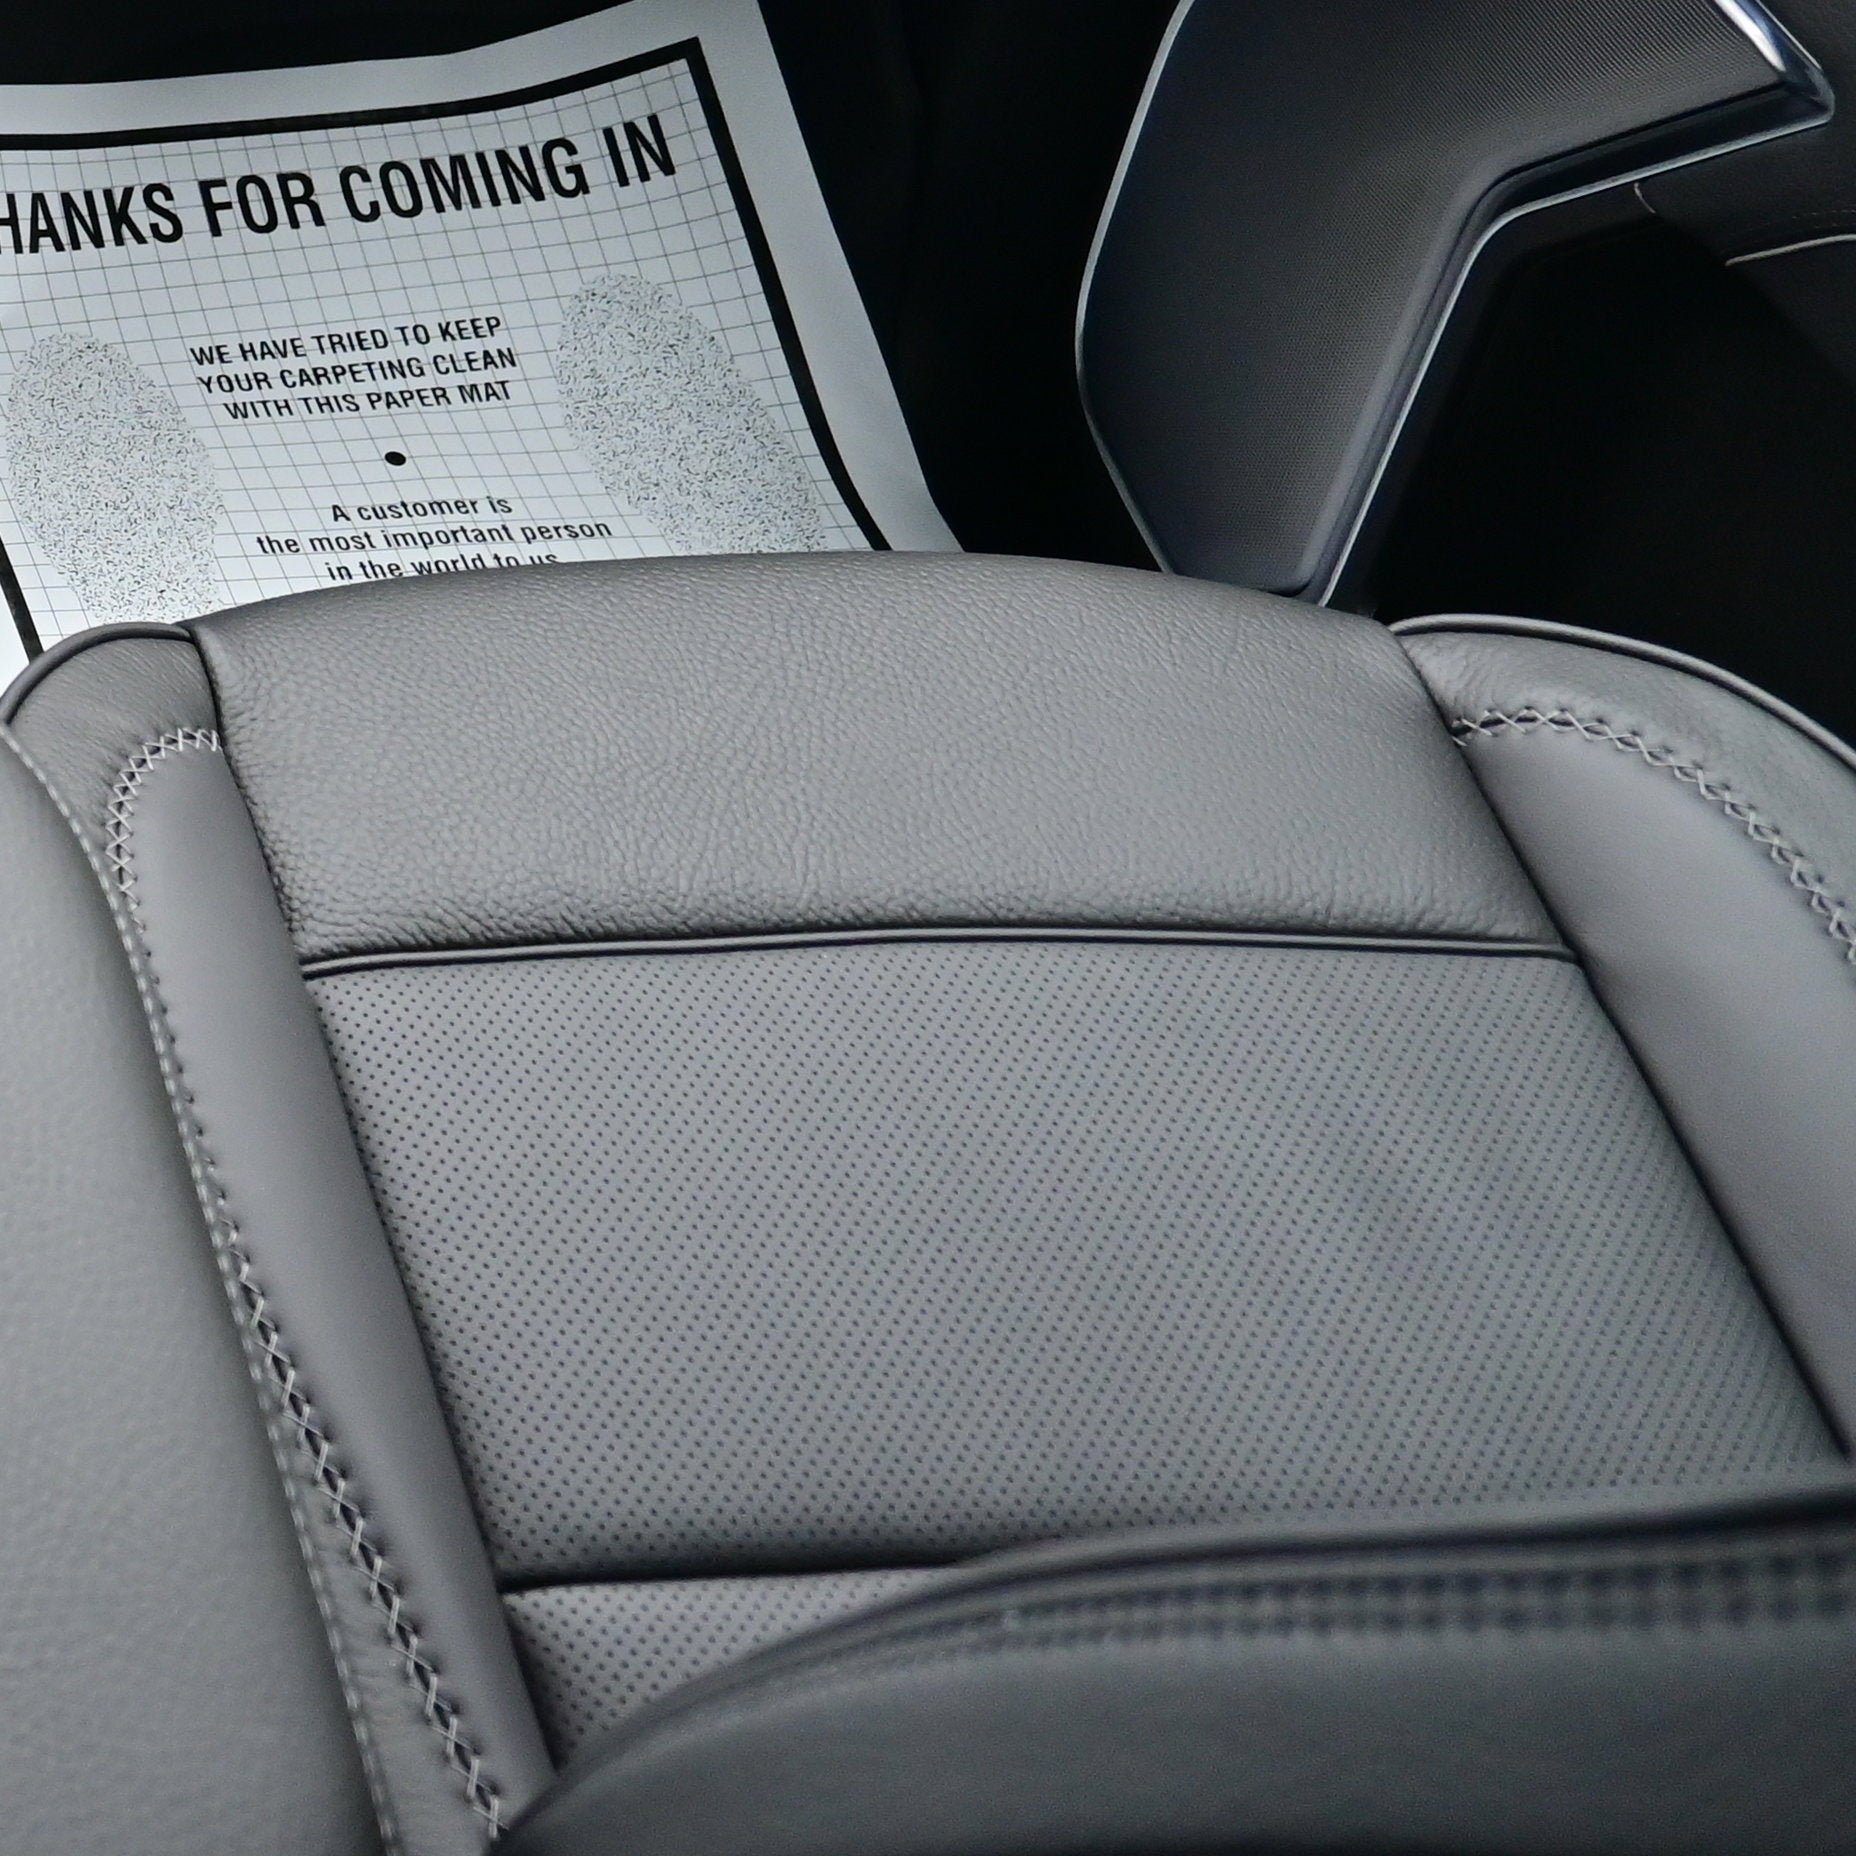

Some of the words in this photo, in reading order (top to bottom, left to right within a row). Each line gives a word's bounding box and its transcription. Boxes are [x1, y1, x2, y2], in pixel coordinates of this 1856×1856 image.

[197, 171, 326, 238] FOR
[338, 137, 591, 224] COMING
[602, 113, 676, 188] IN
[190, 344, 233, 366] WE
[238, 337, 307, 362] HAVE
[310, 328, 390, 355] TRIED
[395, 323, 431, 346] TO
[438, 316, 502, 342] KEEP
[197, 369, 273, 394] YOUR
[279, 357, 426, 390] CARPETING
[433, 346, 518, 375] CLEAN
[223, 398, 293, 420] WITH
[297, 393, 361, 415] THIS
[366, 386, 453, 411] PAPER
[458, 380, 513, 404] MAT
[331, 504, 352, 523] A
[356, 497, 480, 522] customer
[487, 495, 513, 516] is
[257, 534, 301, 555] the
[309, 531, 377, 553] most
[382, 523, 516, 551] important
[520, 520, 613, 546] person
[325, 560, 353, 582] in
[359, 557, 404, 579] the
[411, 553, 486, 575] world
[493, 553, 520, 568] to
